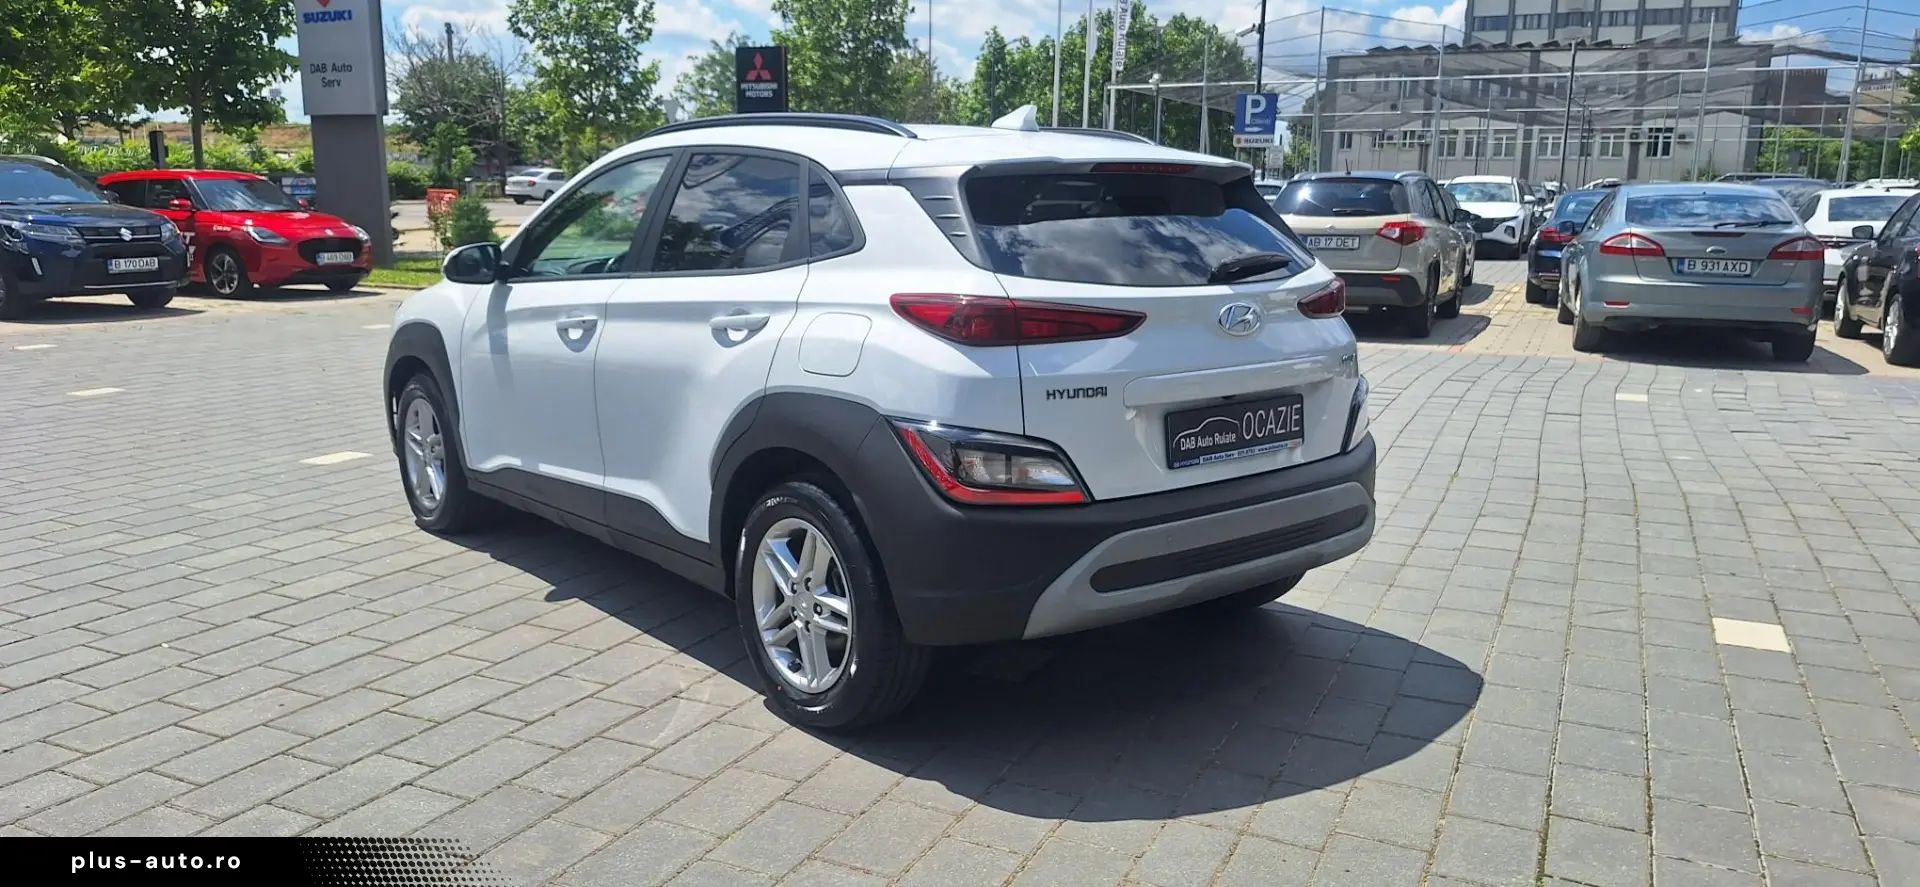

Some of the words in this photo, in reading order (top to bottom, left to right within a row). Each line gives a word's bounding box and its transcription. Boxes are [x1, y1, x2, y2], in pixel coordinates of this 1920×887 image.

[303, 9, 353, 24] SUZUKI
[1118, 6, 1128, 31] Auto
[1115, 33, 1125, 68] Rulate
[309, 62, 328, 74] DAB
[331, 62, 353, 73] Auto
[321, 76, 342, 88] Serv
[745, 90, 774, 98] MOTORS
[1245, 94, 1267, 125] P
[1308, 237, 1321, 247] AB
[1335, 237, 1358, 247] DET
[114, 260, 121, 269] B
[138, 258, 156, 268] DAB
[1687, 260, 1697, 271] B
[1700, 260, 1721, 272] 931
[1721, 261, 1748, 273] AXD
[1046, 386, 1108, 400] HYUNDAI
[1242, 404, 1301, 440] OCAZIE
[1180, 437, 1196, 451] DAB
[1197, 435, 1213, 448] Auto
[1214, 431, 1236, 446] Rulate
